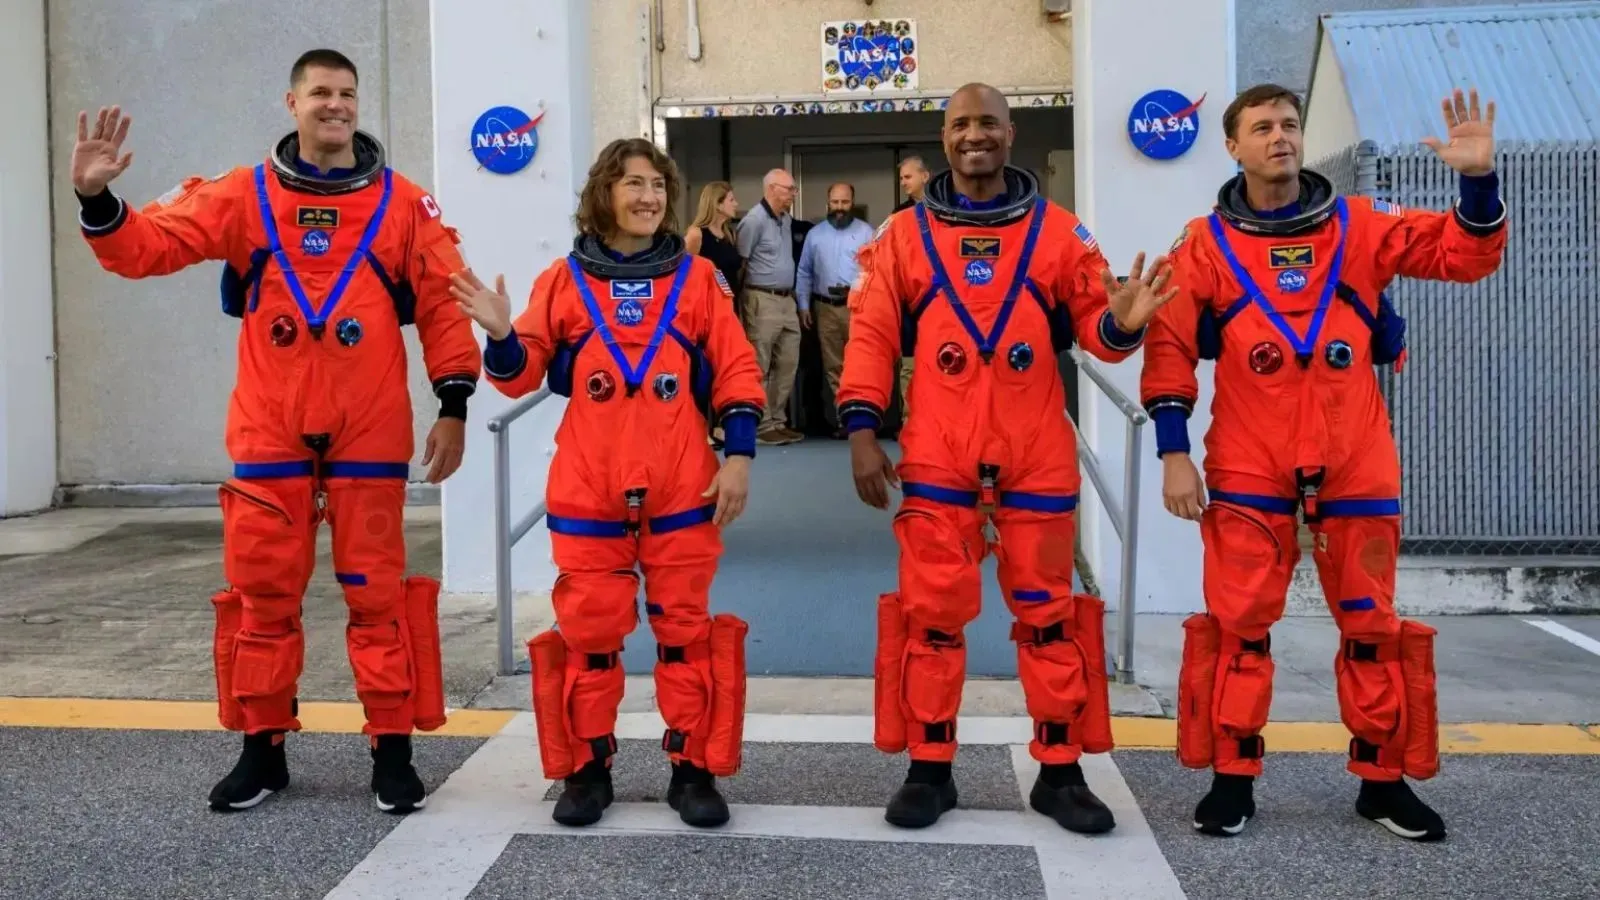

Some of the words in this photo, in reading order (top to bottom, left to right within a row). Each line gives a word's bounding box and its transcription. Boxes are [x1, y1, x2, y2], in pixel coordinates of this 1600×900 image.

[844, 48, 898, 63] NASA
[1134, 116, 1196, 134] NASA
[476, 132, 535, 148] NASA
[304, 238, 329, 247] NASA
[967, 268, 993, 277] NASA
[1279, 275, 1307, 285] NASA
[618, 308, 643, 318] NASA
